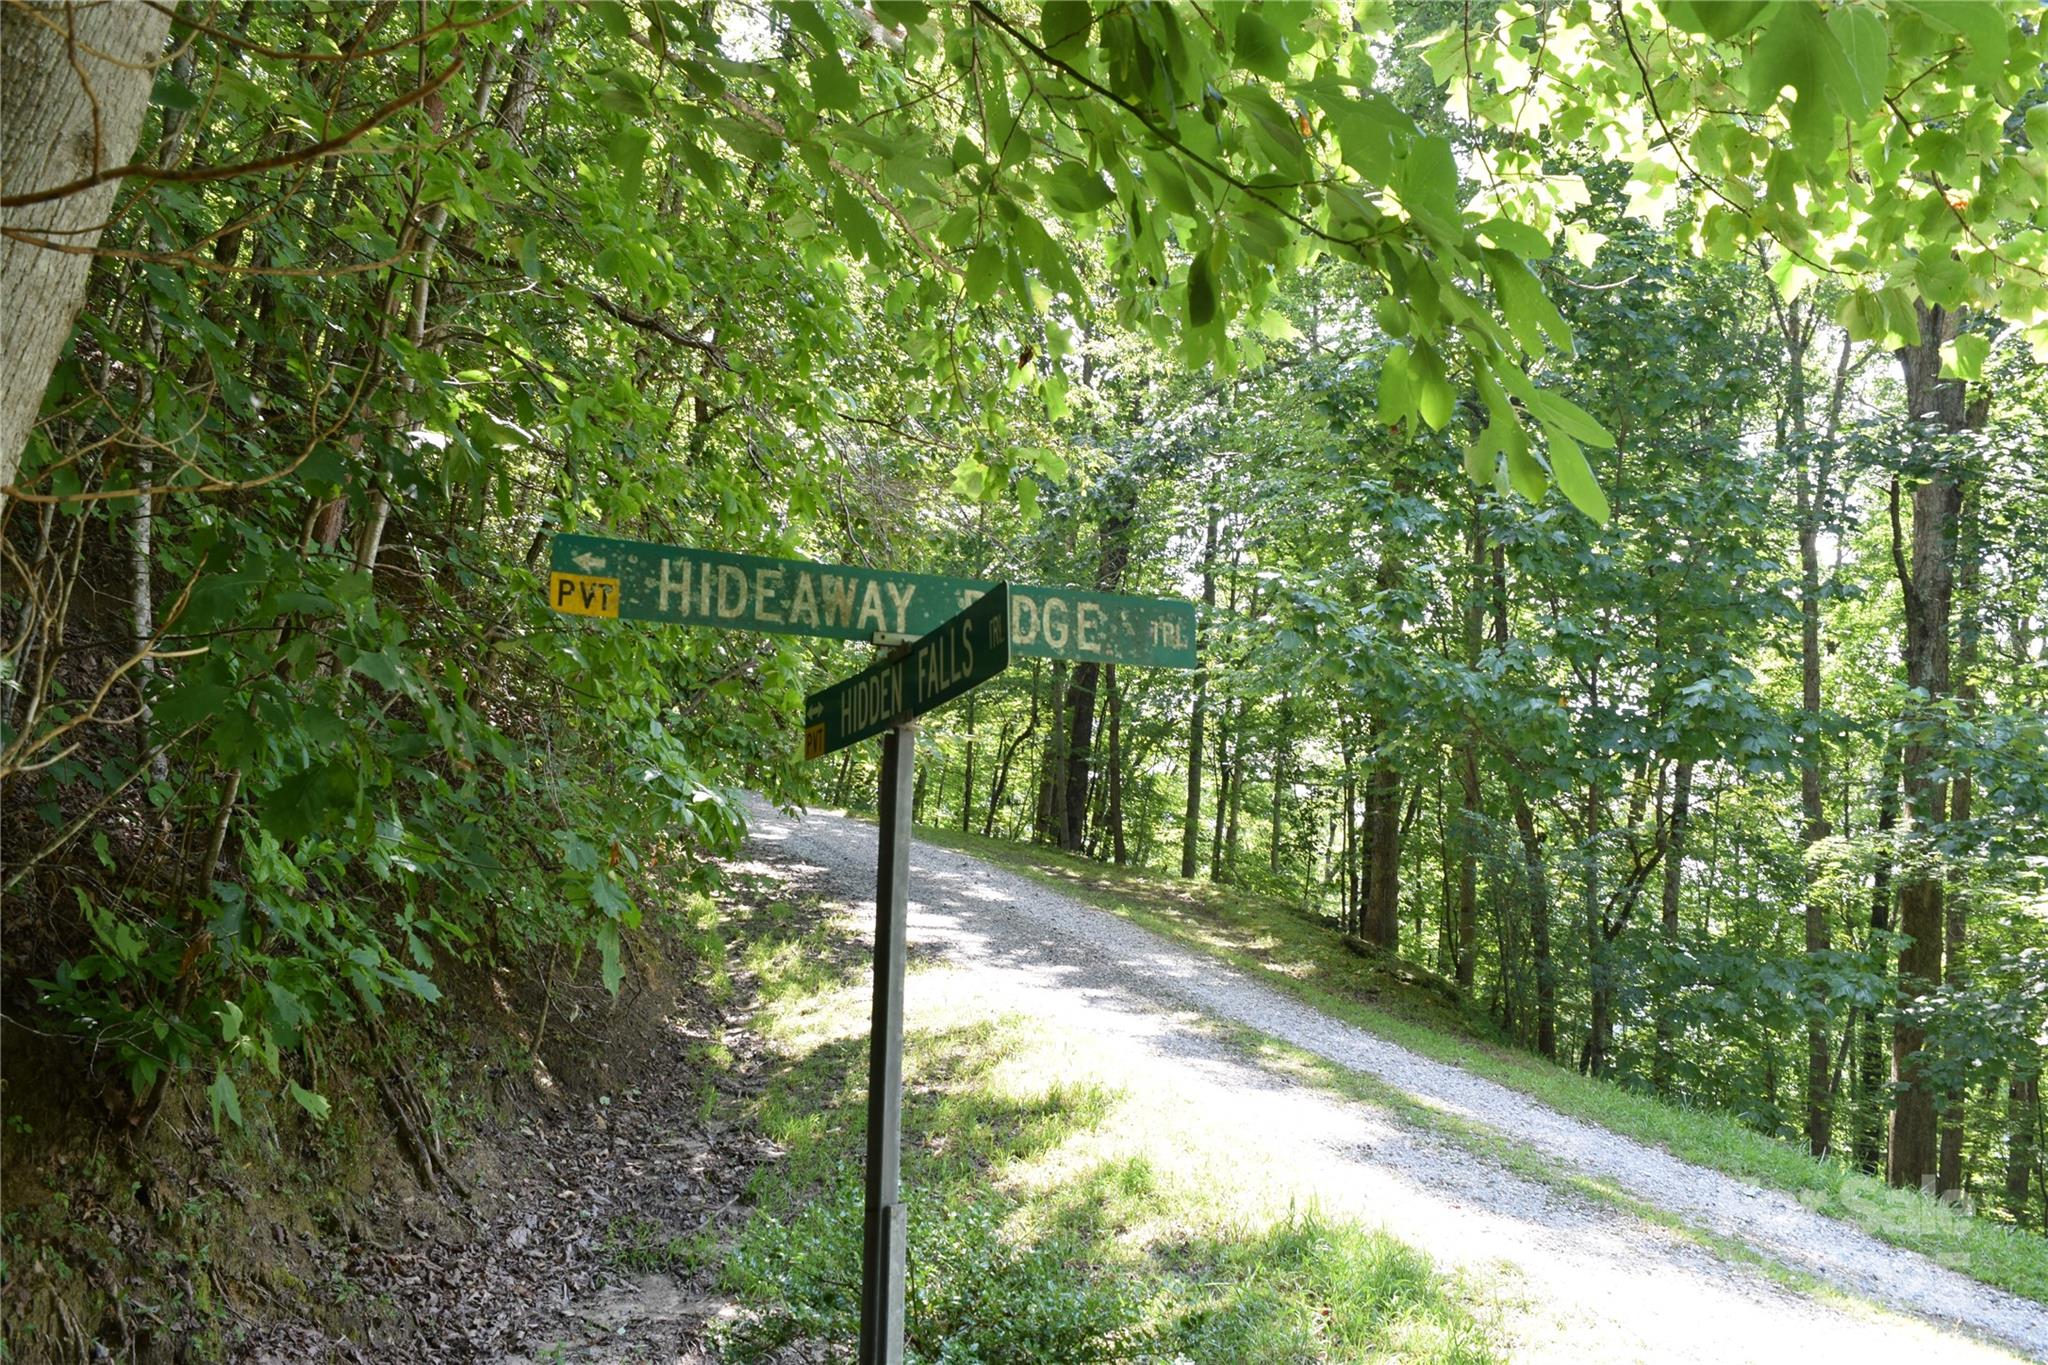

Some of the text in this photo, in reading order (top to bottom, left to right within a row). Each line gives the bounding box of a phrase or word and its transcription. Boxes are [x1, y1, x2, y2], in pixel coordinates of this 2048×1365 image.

[557, 578, 615, 611] PVT
[658, 558, 1189, 651] HIDEAWAY DGE TRL
[840, 613, 1006, 738] HIDDEN FALLS TRL
[805, 728, 823, 757] PVT
